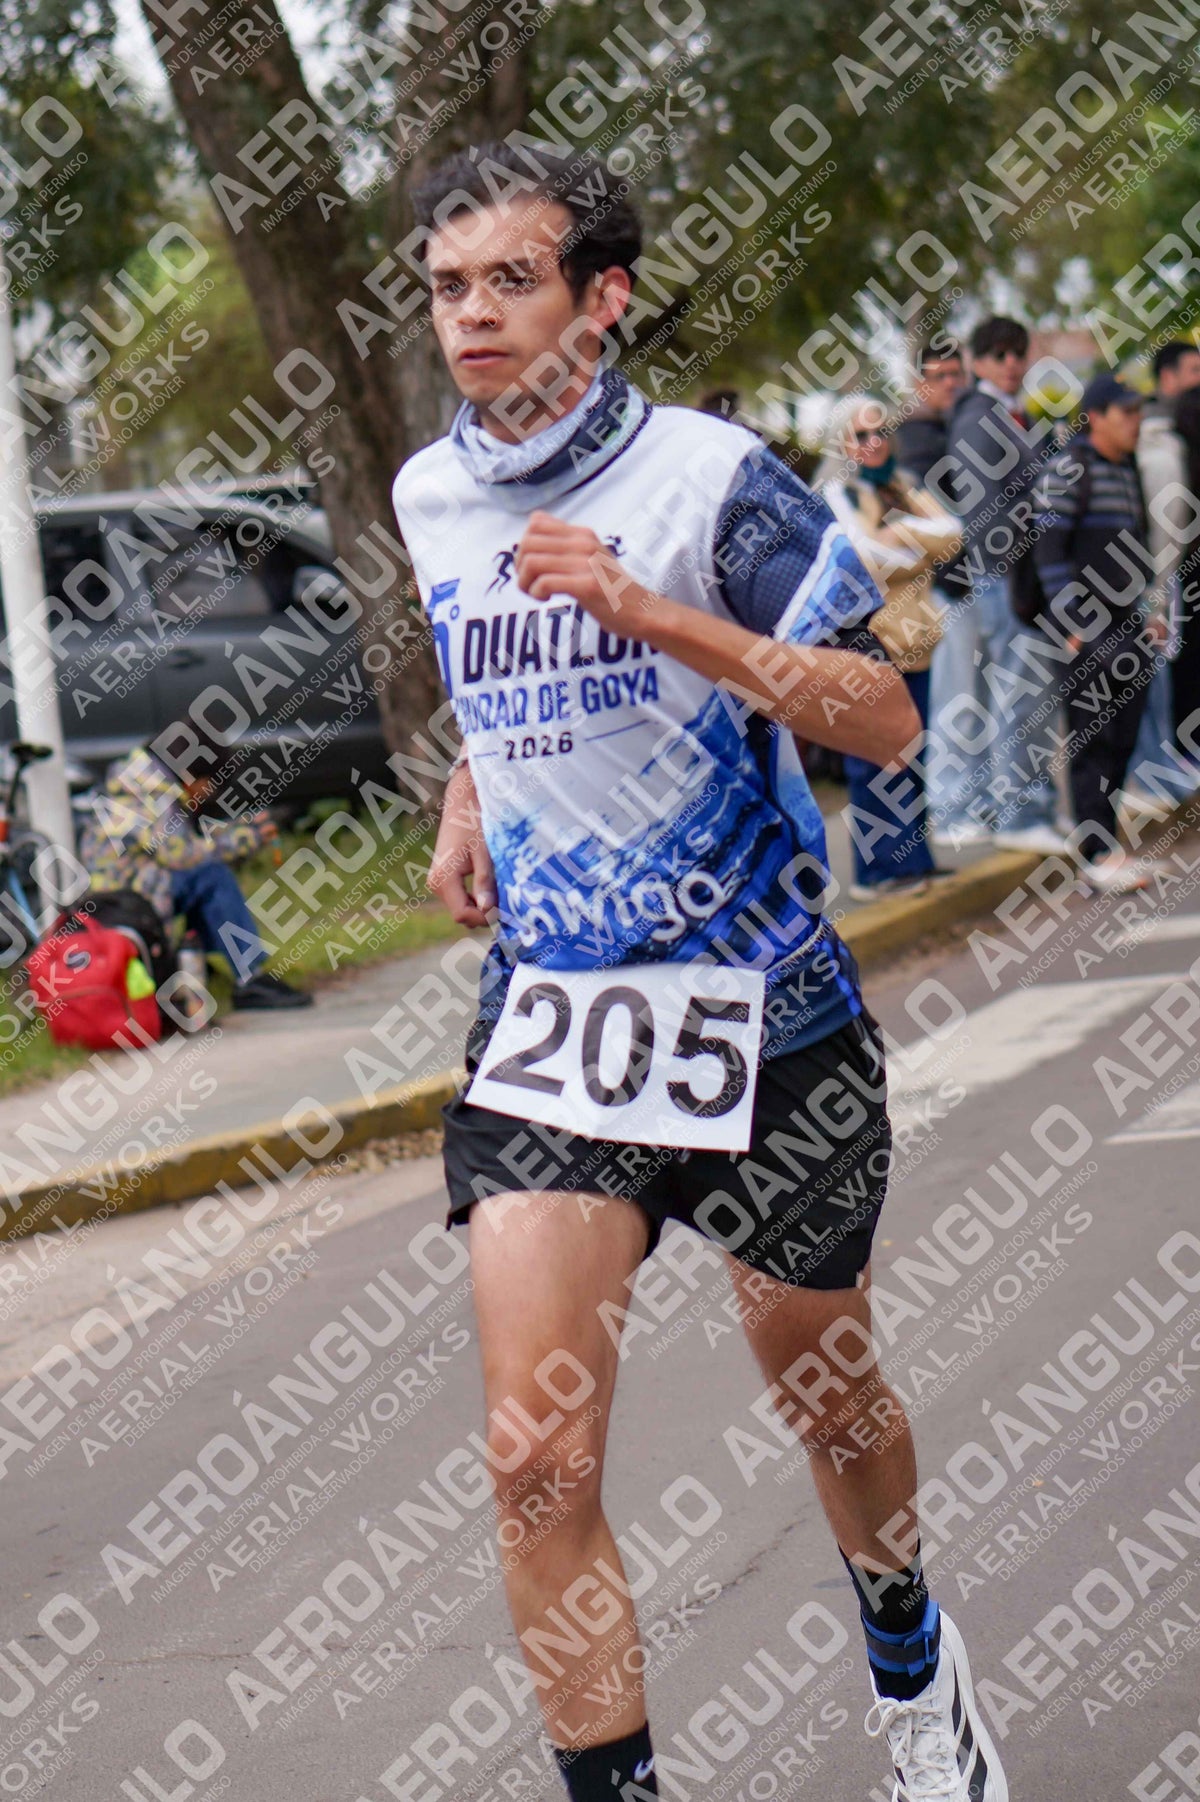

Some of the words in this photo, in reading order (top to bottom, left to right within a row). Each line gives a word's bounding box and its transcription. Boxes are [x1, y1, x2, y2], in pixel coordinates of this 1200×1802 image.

[538, 680, 572, 723] DE
[581, 665, 660, 716] GOYA
[505, 731, 574, 761] 2026
[484, 982, 748, 1119] 205
